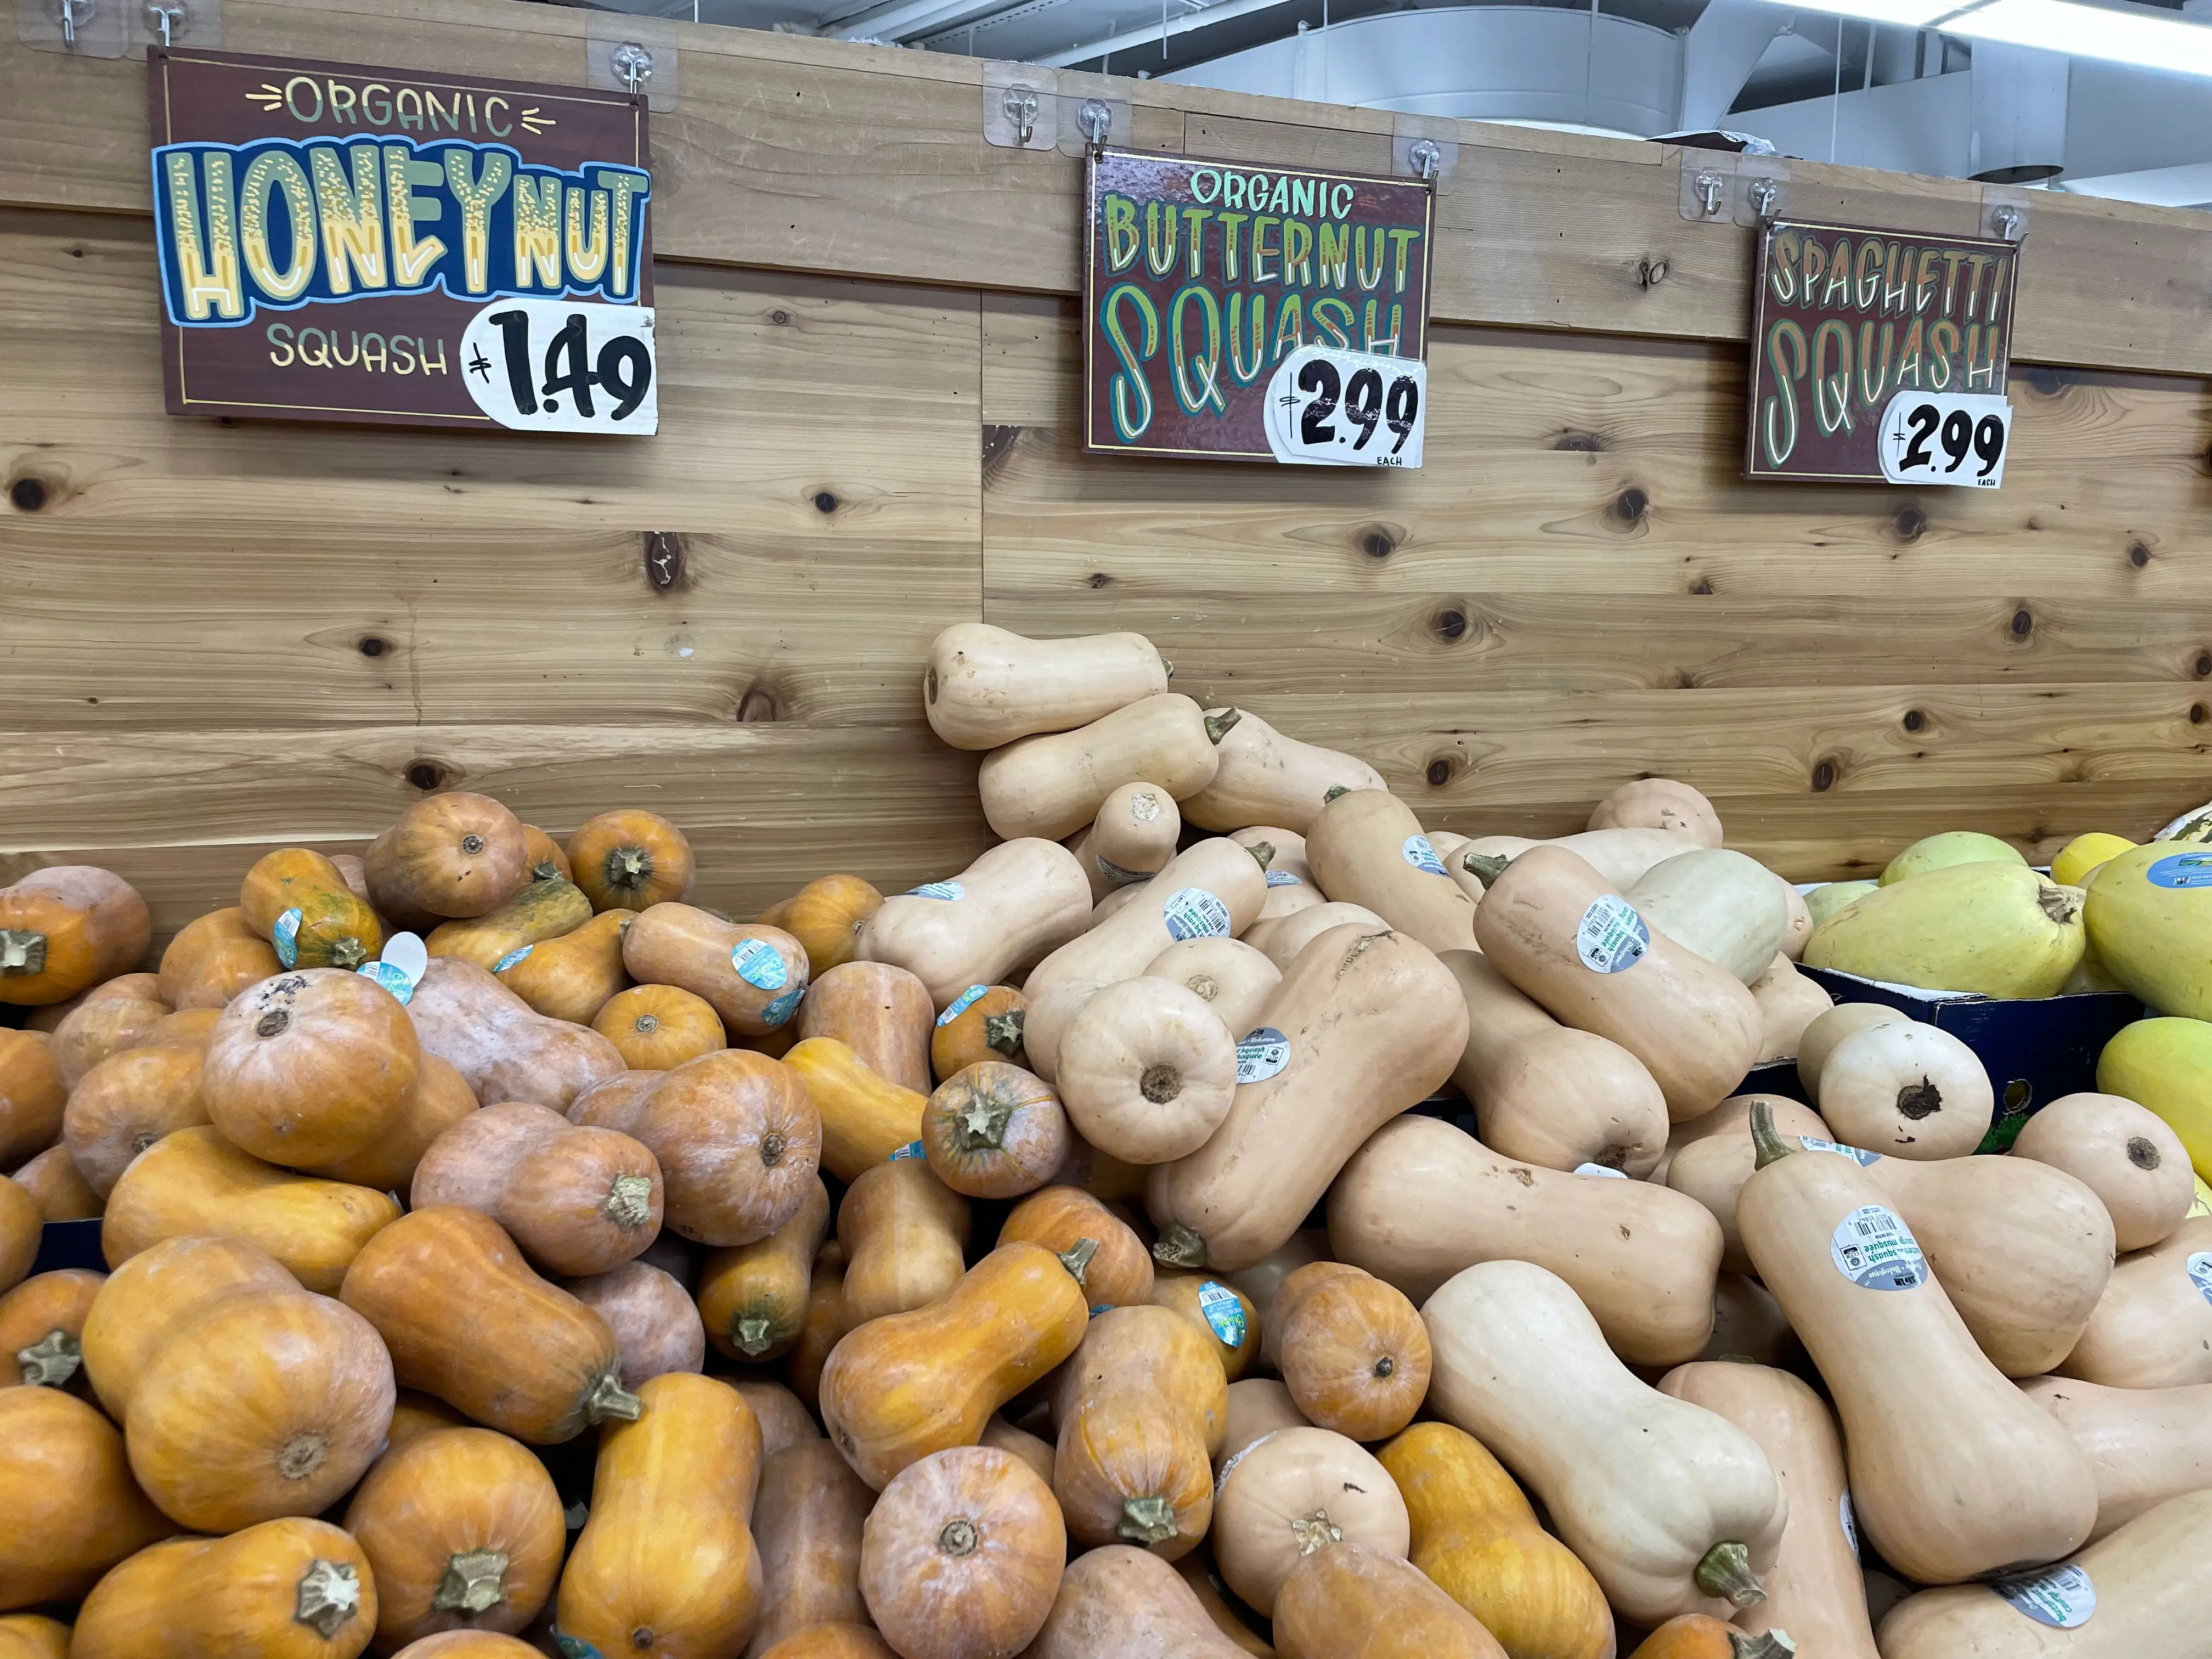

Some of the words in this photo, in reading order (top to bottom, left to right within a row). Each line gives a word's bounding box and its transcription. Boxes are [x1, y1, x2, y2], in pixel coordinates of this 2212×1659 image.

[285, 76, 512, 137] ORGANIC
[1190, 170, 1354, 219] ORGANIC
[1103, 192, 1421, 295] BUTTERNUT
[1771, 231, 2010, 322] SPAGHETTI
[268, 323, 447, 376] SQUASH
[1102, 284, 1403, 441] SQUASH
[1280, 359, 1419, 454] $2.99
[1765, 319, 2000, 467] SQUASH
[1377, 456, 1402, 467] EACH
[1893, 404, 2005, 477] $2.99
[1183, 912, 1201, 933] squash
[1188, 907, 1210, 933] musquée
[1608, 930, 1625, 950] squash
[1858, 1215, 1875, 1224] 65842
[1864, 1239, 1897, 1252] musquée
[1868, 1248, 1896, 1263] squash
